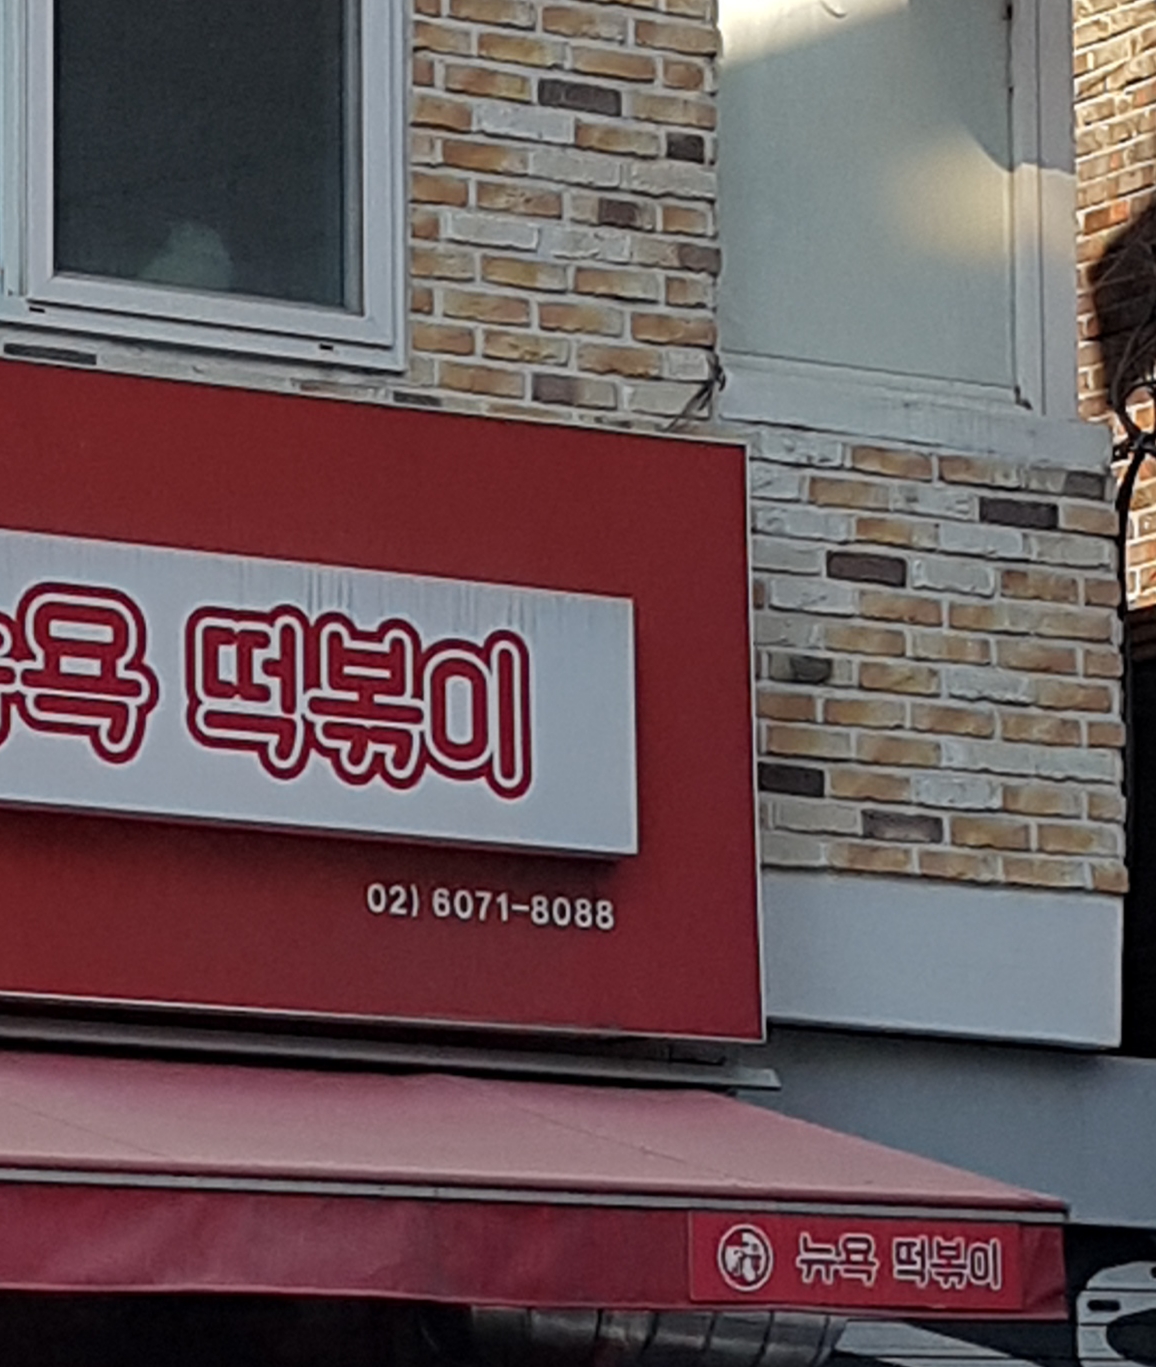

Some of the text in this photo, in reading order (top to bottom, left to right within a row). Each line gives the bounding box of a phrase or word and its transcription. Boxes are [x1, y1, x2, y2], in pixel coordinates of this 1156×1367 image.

[184, 603, 533, 801] 떡볶이
[431, 888, 615, 931] 6071-8088
[796, 1231, 1002, 1291] 뉴욕 떡볶이
